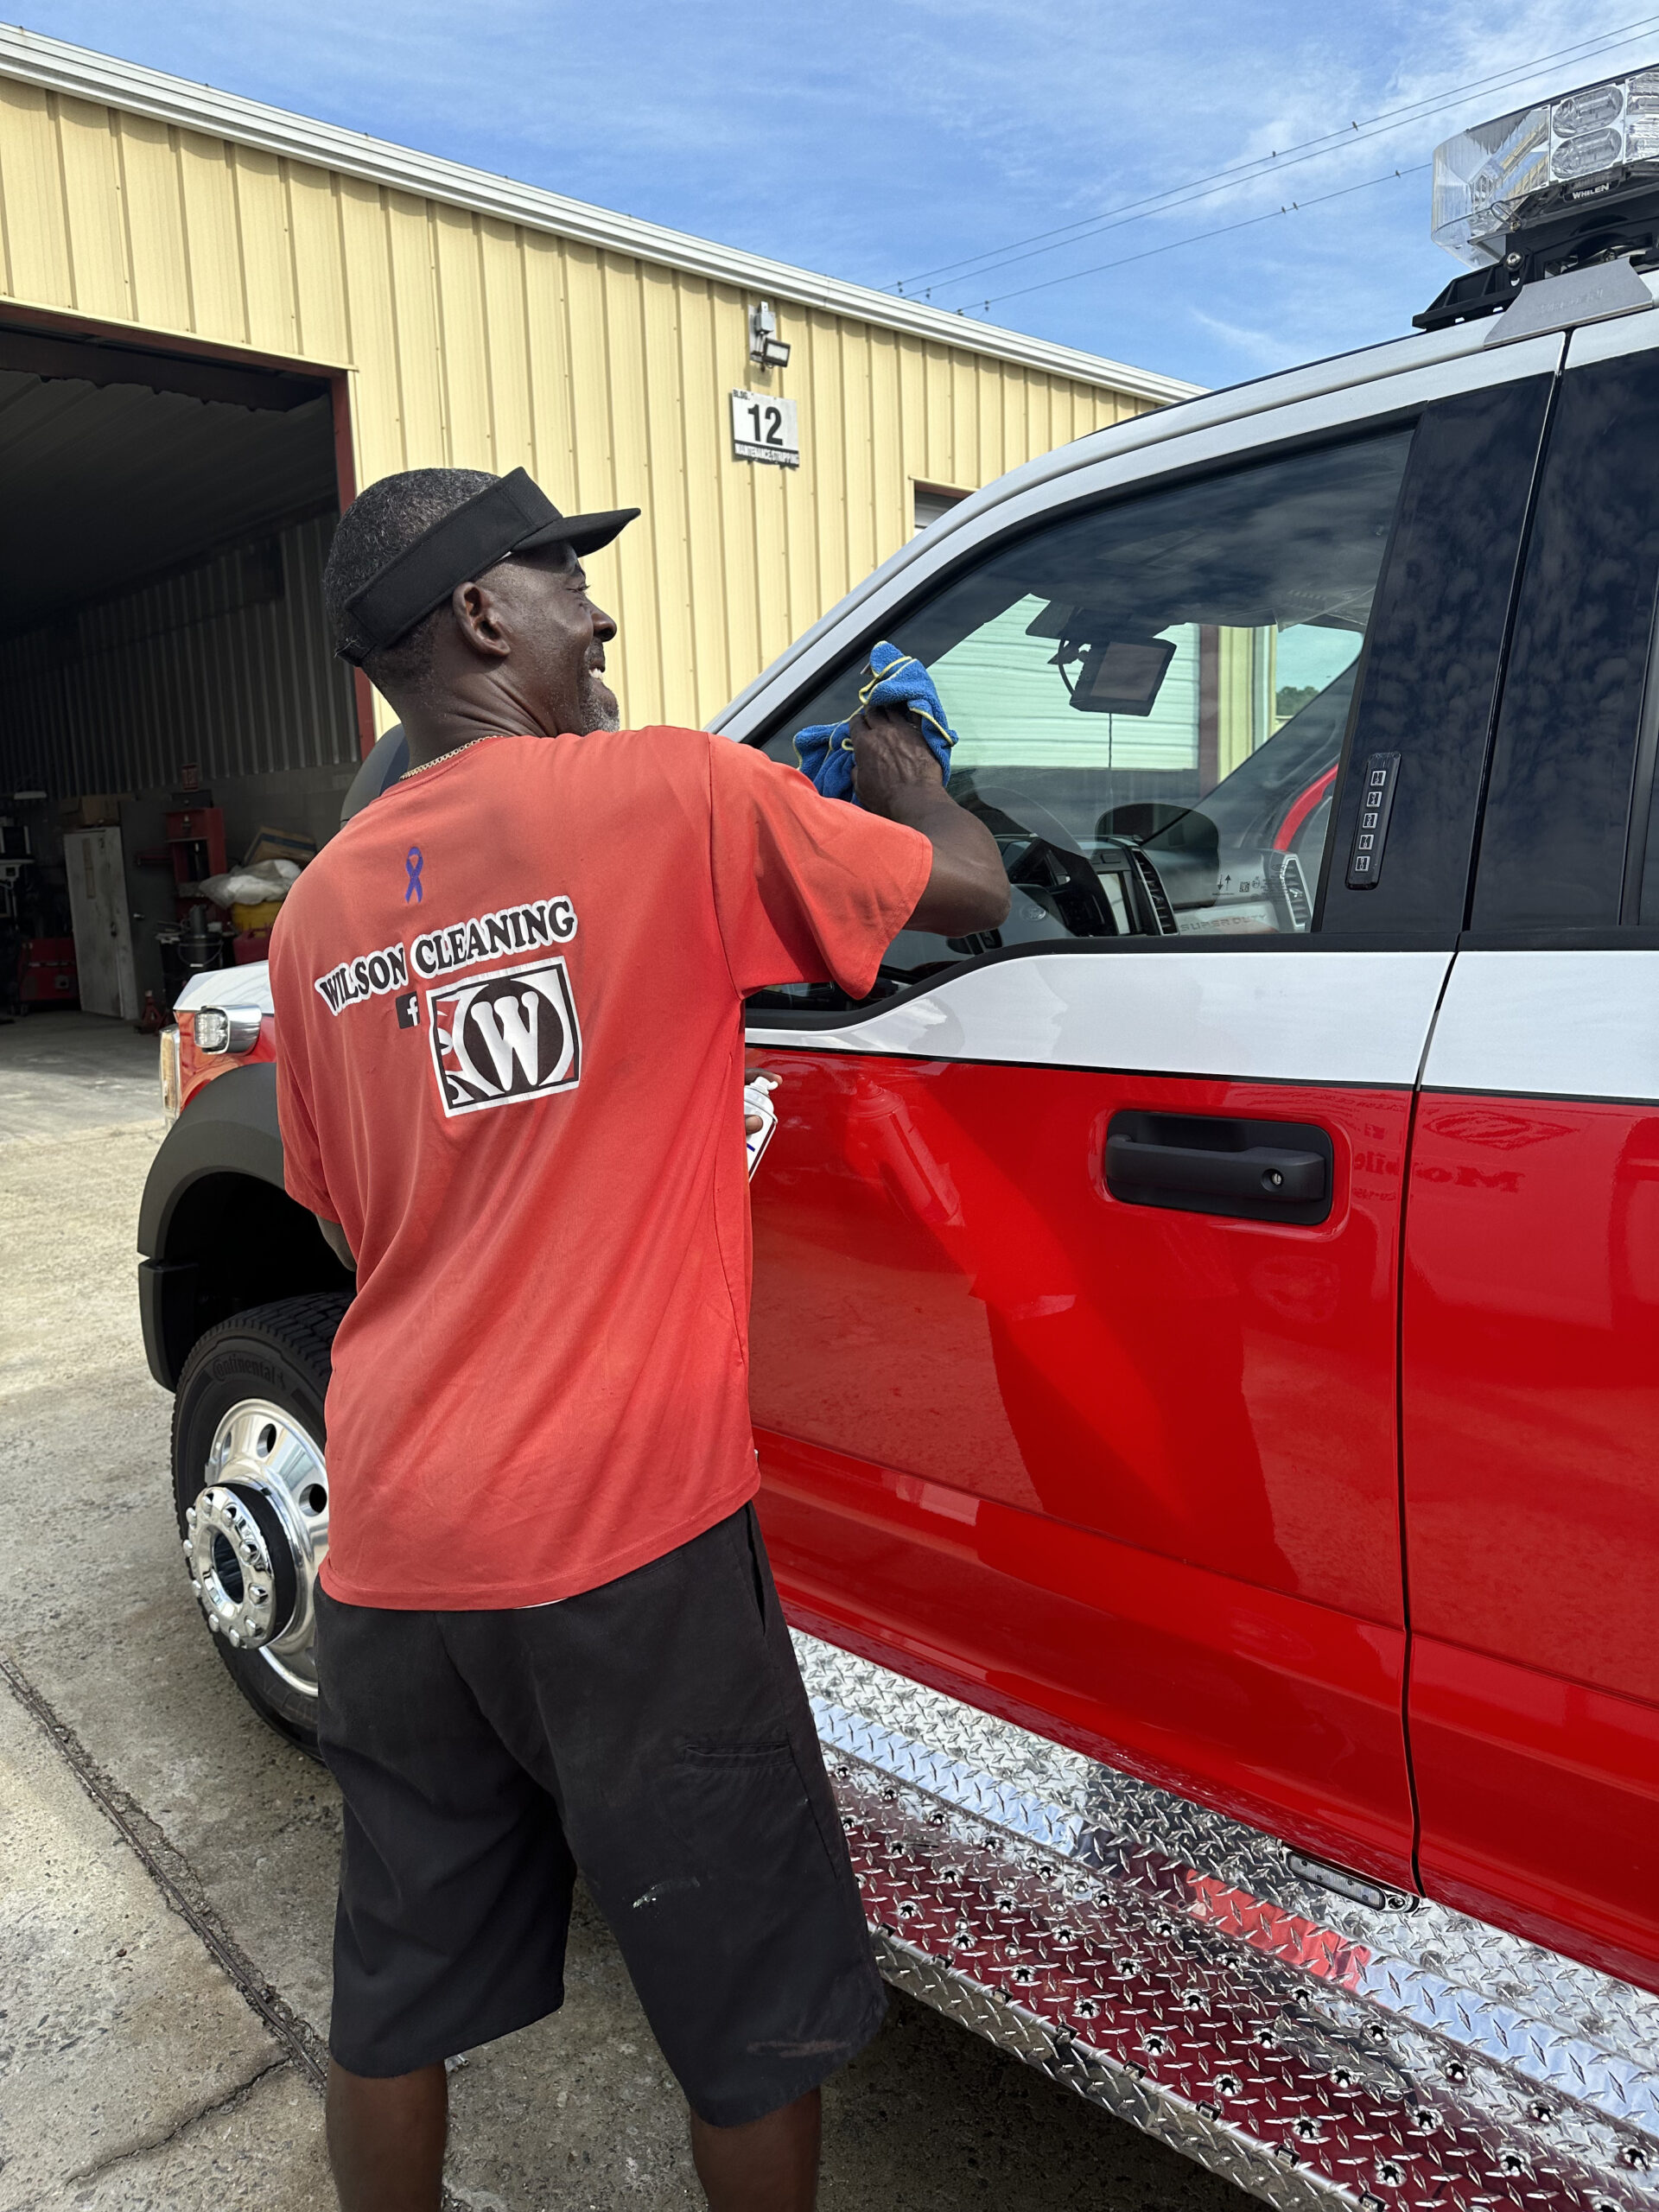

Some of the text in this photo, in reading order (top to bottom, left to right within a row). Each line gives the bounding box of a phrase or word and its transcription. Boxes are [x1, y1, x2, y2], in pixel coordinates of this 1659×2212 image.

[1572, 182, 1610, 200] WHELEN
[747, 404, 783, 446] 12
[317, 899, 576, 1014] WILSON CLEANING
[470, 990, 539, 1091] W
[214, 1353, 275, 1384] Continental
